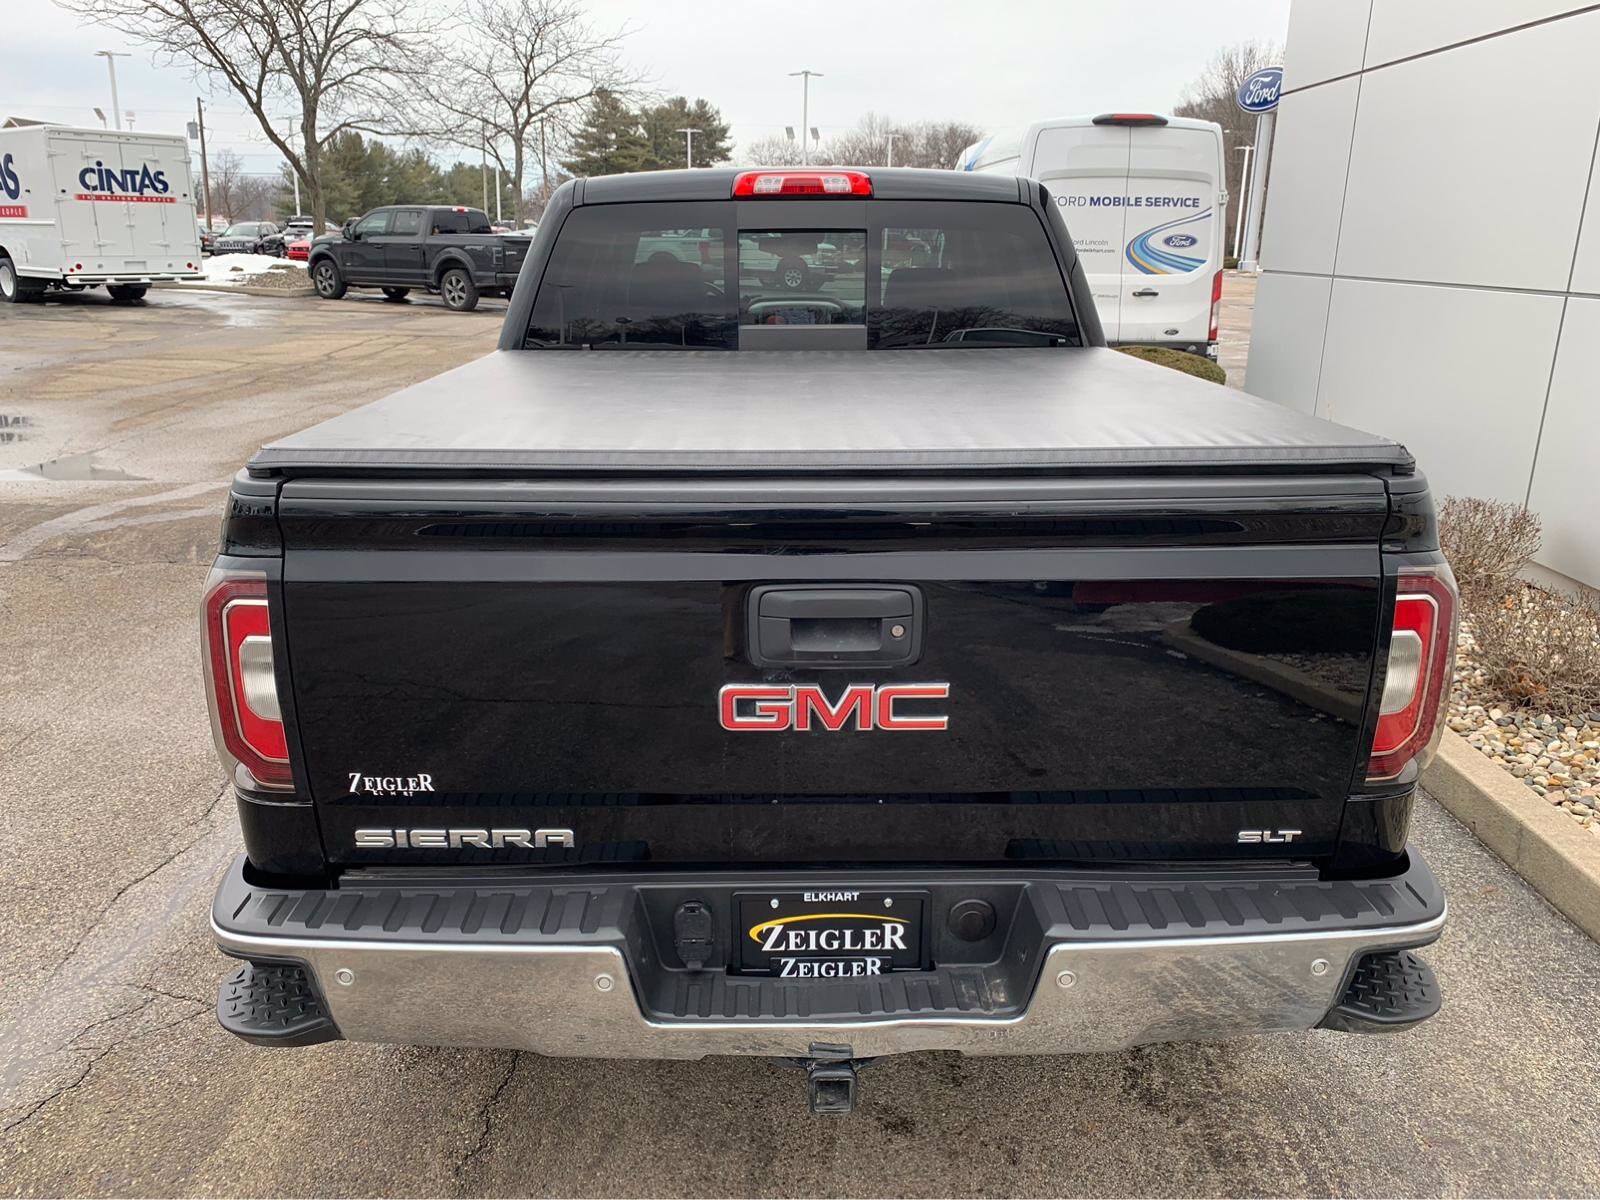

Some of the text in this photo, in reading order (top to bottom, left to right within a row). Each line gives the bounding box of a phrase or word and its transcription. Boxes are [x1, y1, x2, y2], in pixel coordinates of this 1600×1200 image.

[1245, 76, 1281, 105] Ford
[1089, 196, 1142, 207] MOBILE
[1144, 197, 1200, 208] SERVICE
[1169, 235, 1192, 247] Ford
[718, 683, 950, 732] GMC
[354, 828, 576, 849] SIERRA
[1237, 829, 1303, 843] SLT
[803, 891, 860, 902] ELKHART
[761, 922, 908, 952] ZEIGLER
[779, 957, 882, 978] ZEIGLER
